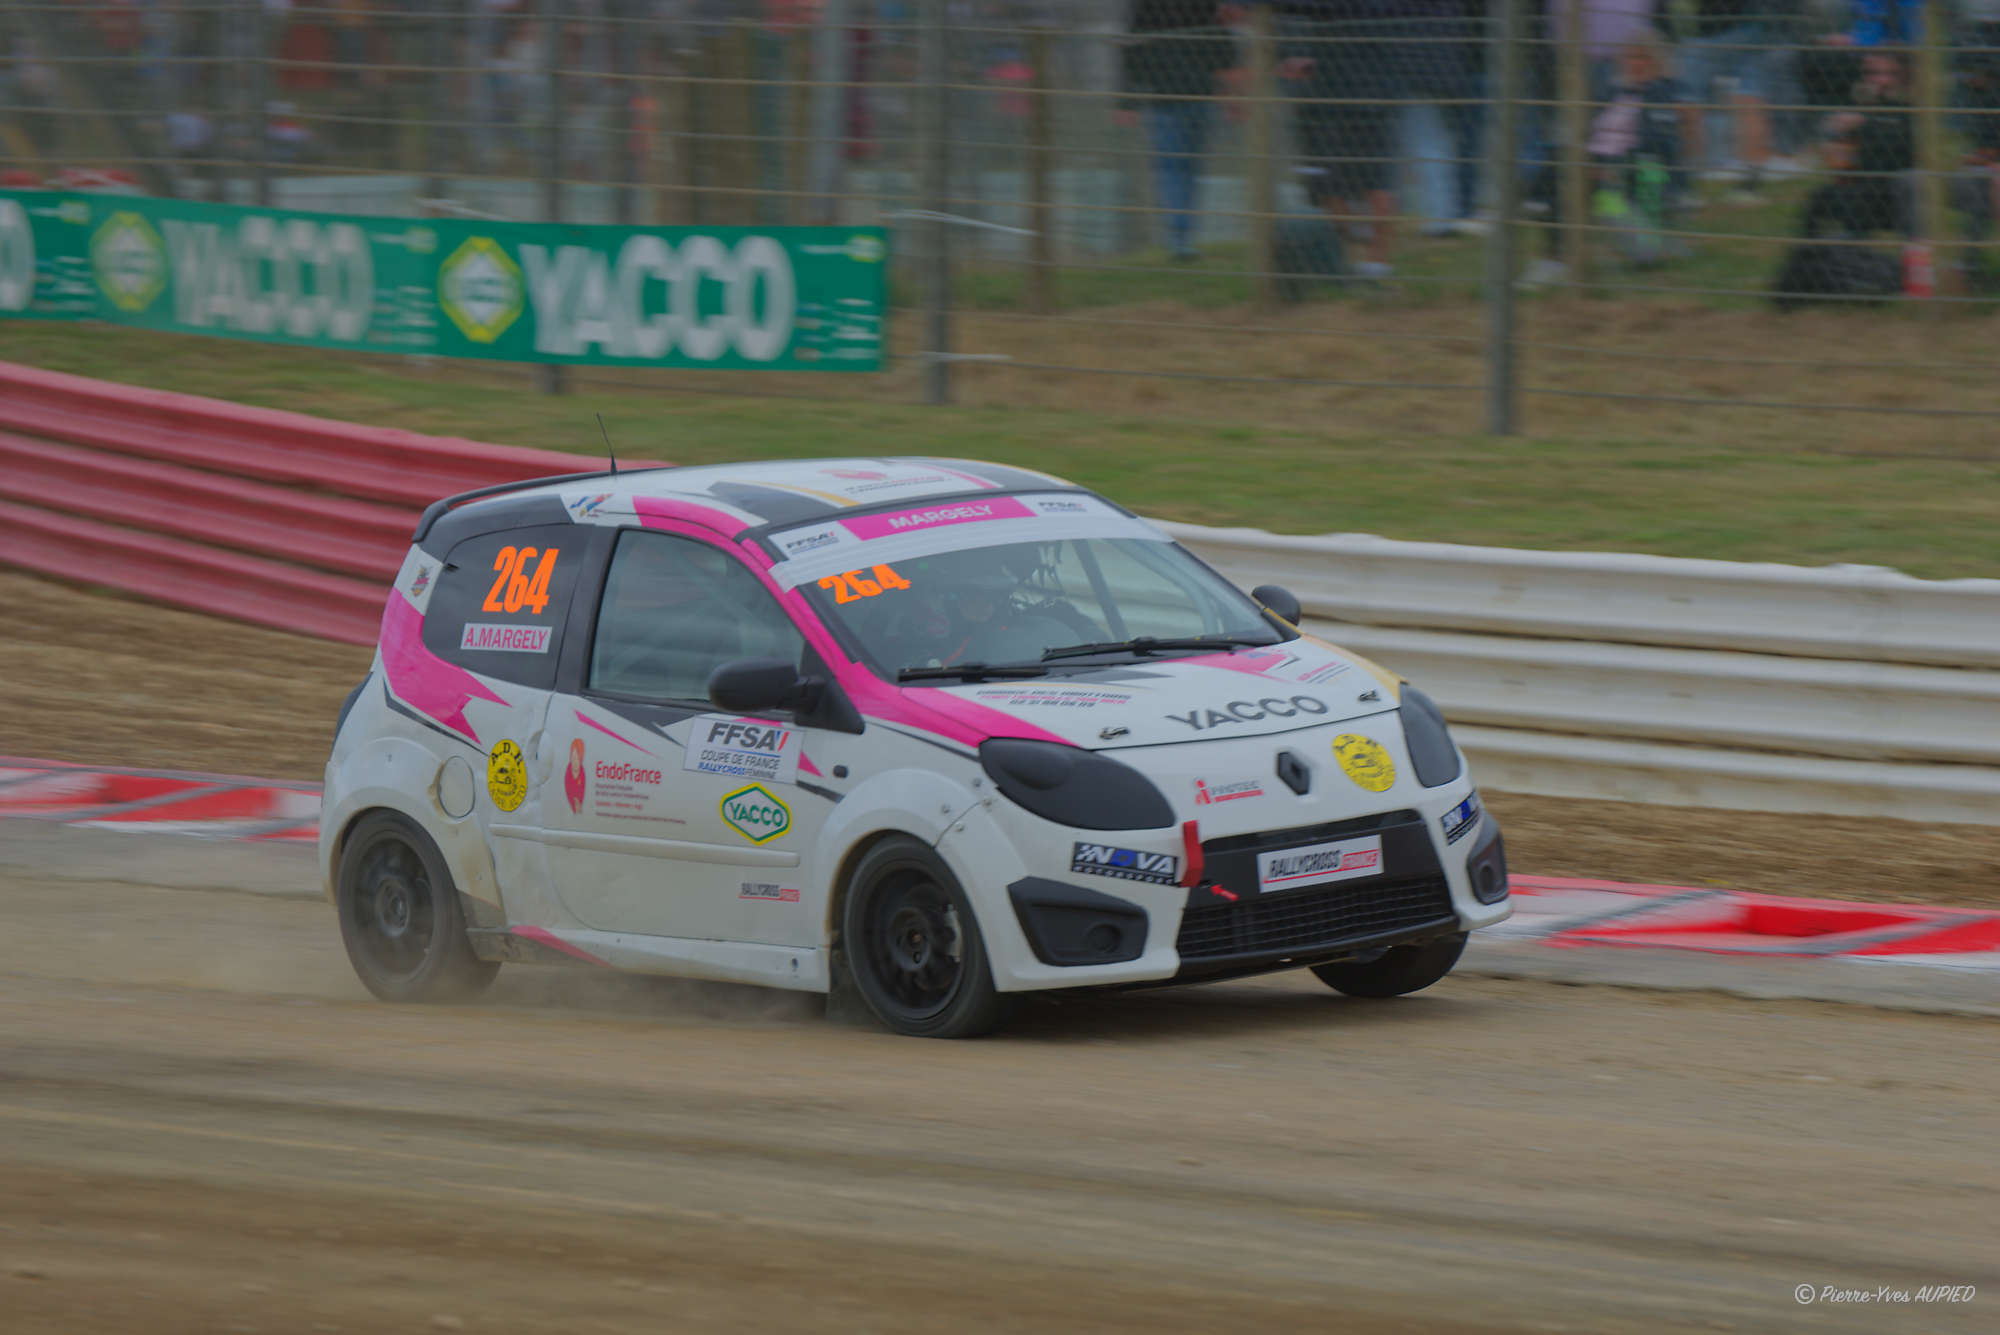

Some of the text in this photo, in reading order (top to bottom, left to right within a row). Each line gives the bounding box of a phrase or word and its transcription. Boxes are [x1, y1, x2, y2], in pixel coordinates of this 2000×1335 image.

[162, 215, 374, 341] YACCO
[517, 234, 797, 362] YACCO
[888, 503, 994, 530] MARGELY
[482, 546, 560, 614] 264
[817, 563, 912, 605] 264
[463, 627, 549, 650] A.MARGELY
[1164, 695, 1330, 731] YACCO
[707, 722, 776, 751] FFSA
[595, 760, 662, 785] EndoFrance
[700, 750, 781, 770] COUPE DE FRANCE
[729, 802, 784, 827] YACCO
[1083, 845, 1174, 873] NOVA
